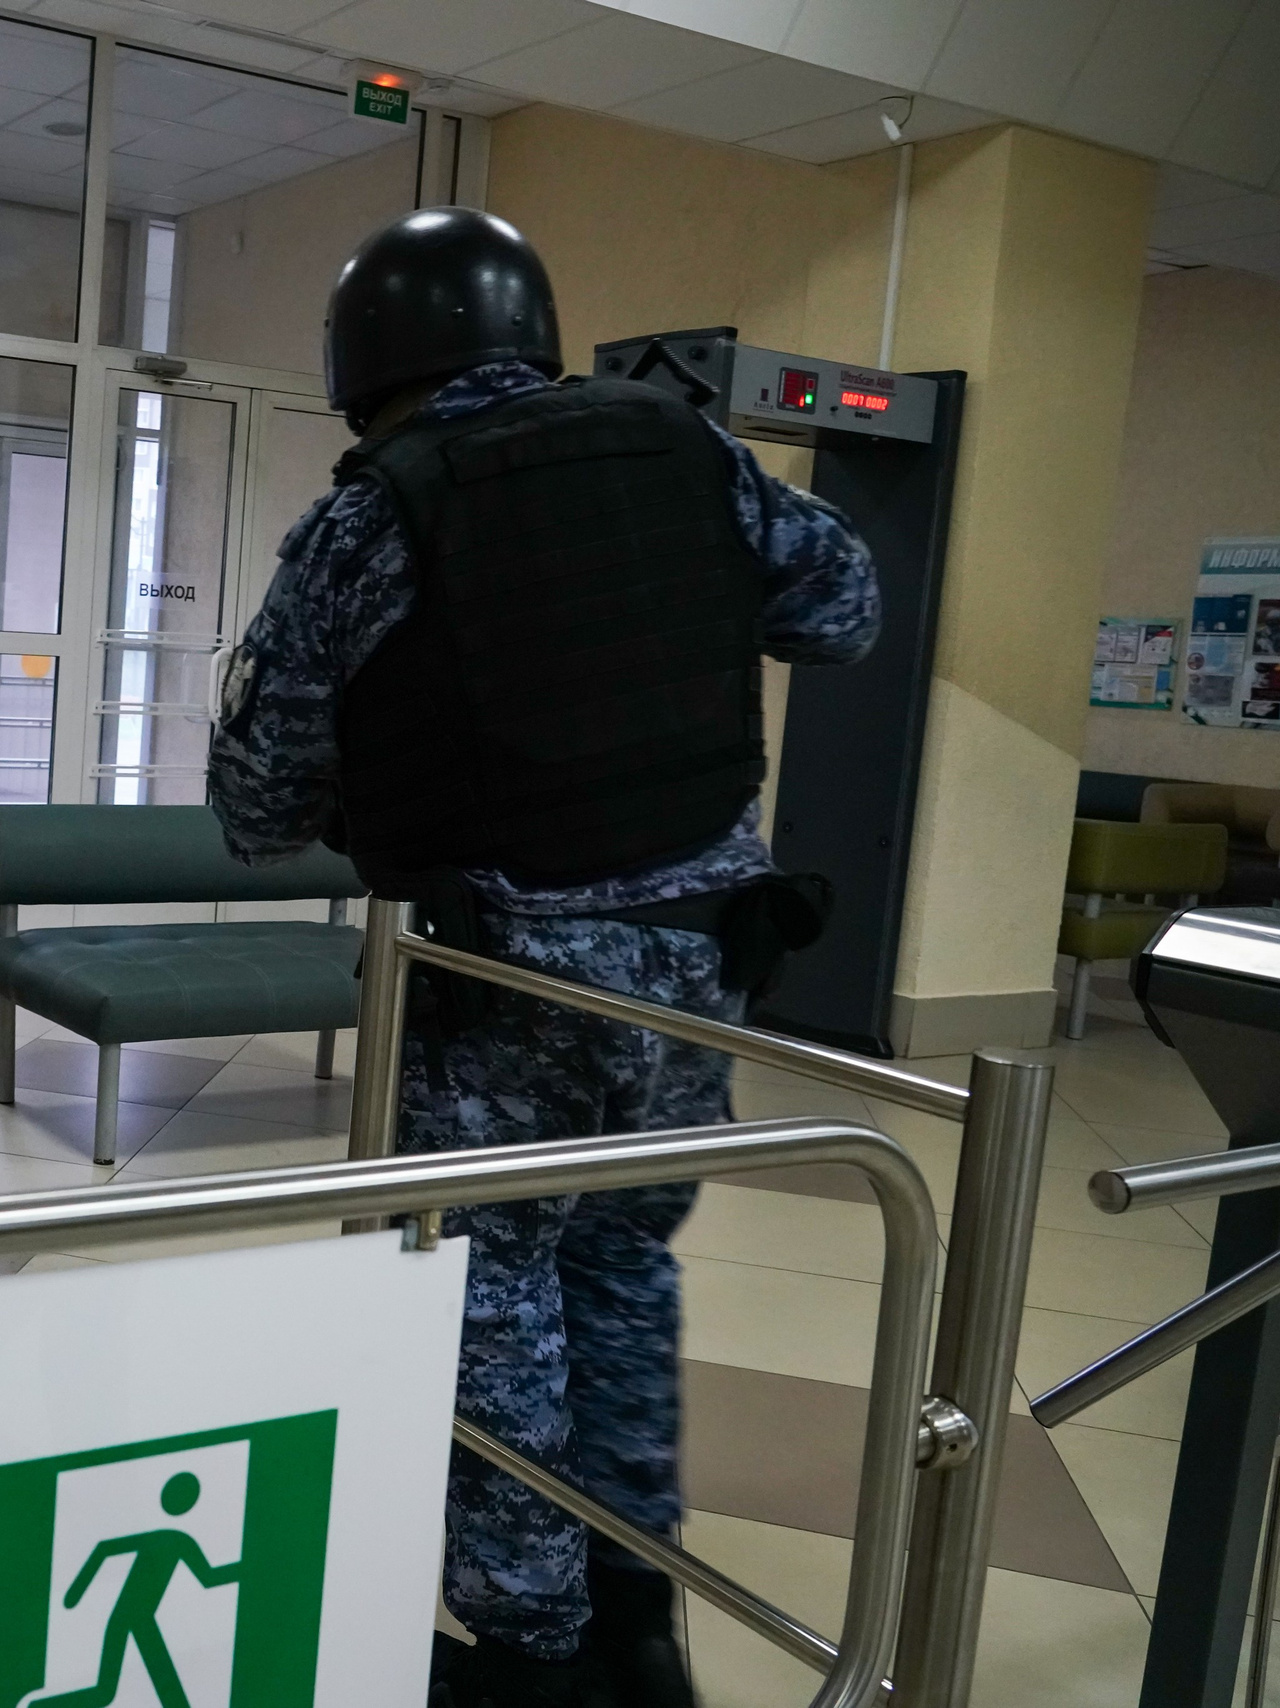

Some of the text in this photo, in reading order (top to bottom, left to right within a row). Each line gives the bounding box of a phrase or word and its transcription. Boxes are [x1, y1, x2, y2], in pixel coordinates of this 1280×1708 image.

[362, 87, 402, 107] ВЫХОД
[369, 102, 393, 115] EXIT
[139, 583, 195, 602] ВЫХОД
